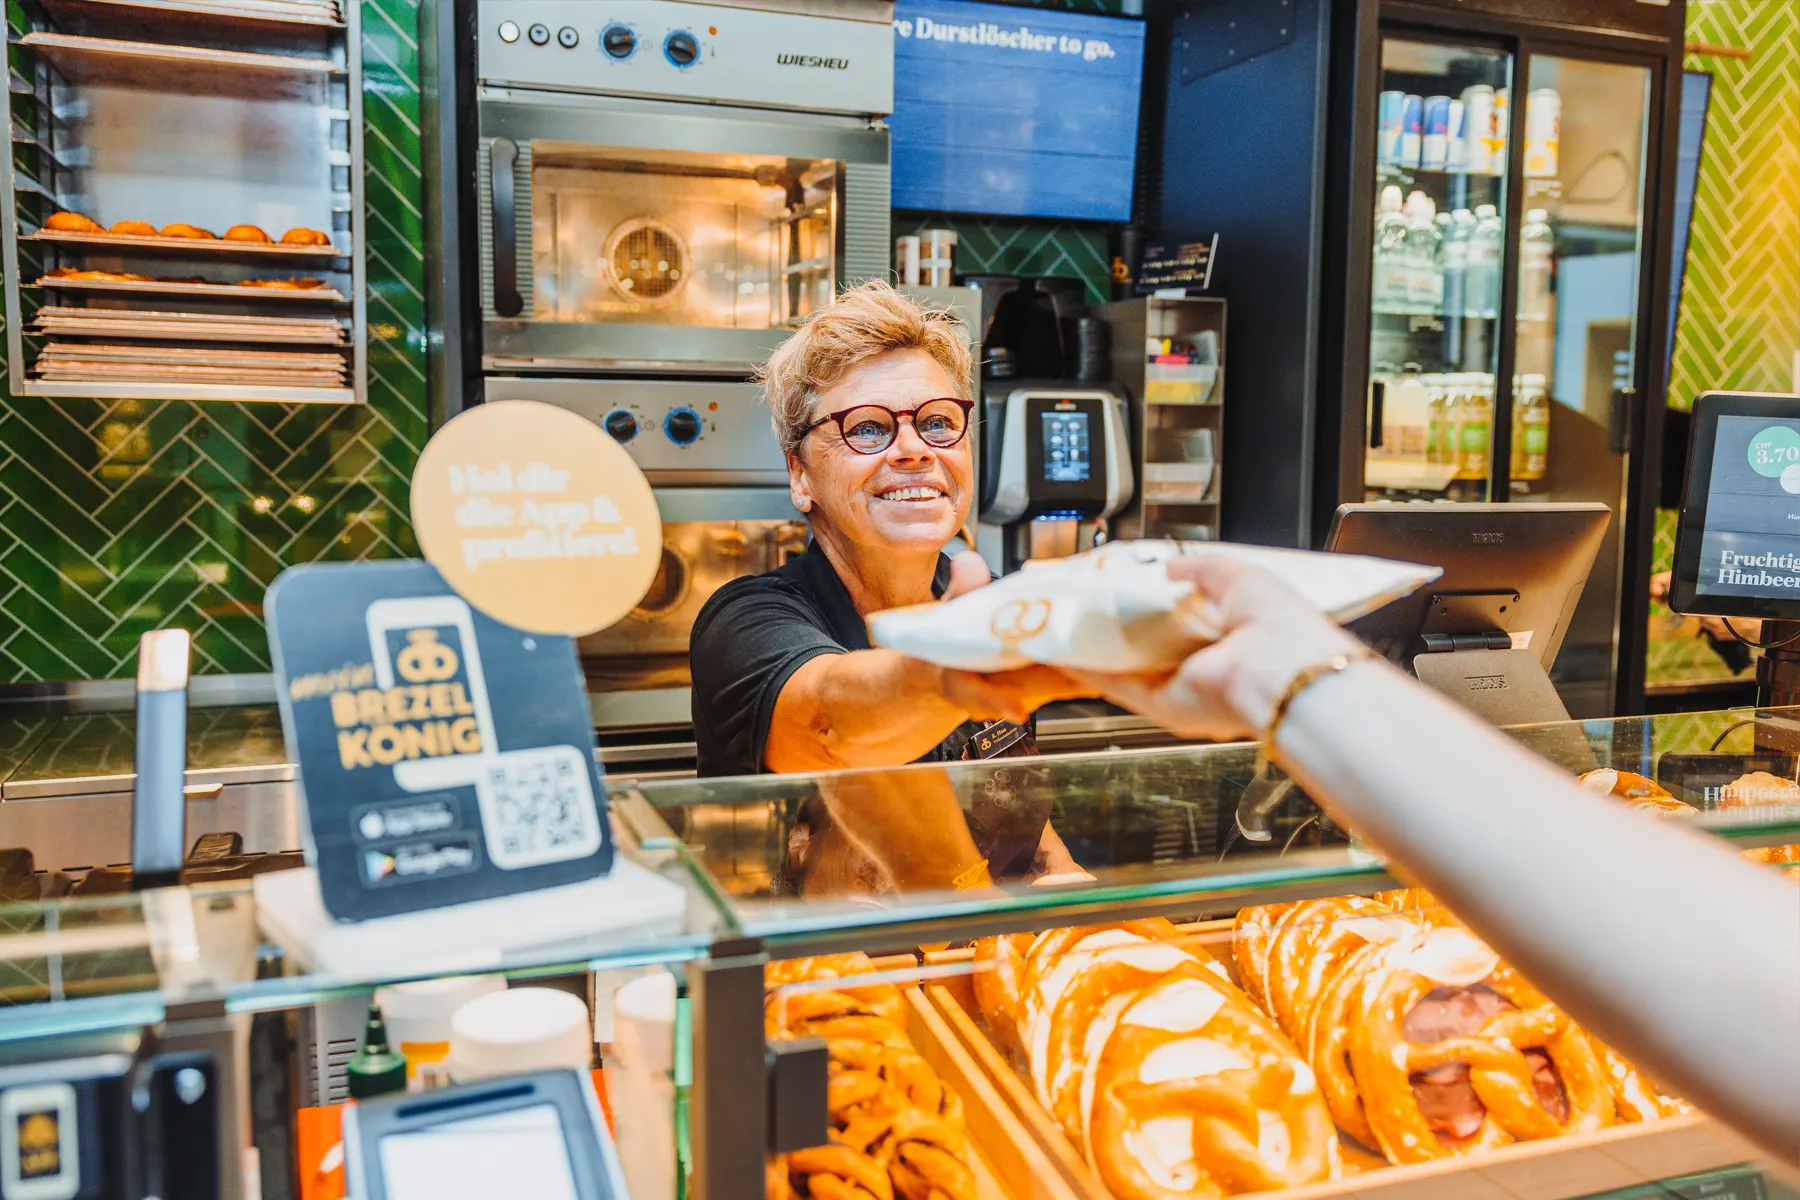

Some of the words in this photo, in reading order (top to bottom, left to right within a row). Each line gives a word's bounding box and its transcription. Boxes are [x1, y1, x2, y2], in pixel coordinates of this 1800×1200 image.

[916, 17, 1057, 52] Durstlöscher
[1059, 35, 1082, 54] to
[1083, 40, 1116, 61] go.
[777, 53, 849, 70] WIESHEU
[1755, 441, 1773, 450] CHF
[1757, 446, 1800, 465] 3.70
[455, 496, 514, 527] die
[519, 498, 590, 531] App
[331, 681, 473, 728] BREZEL
